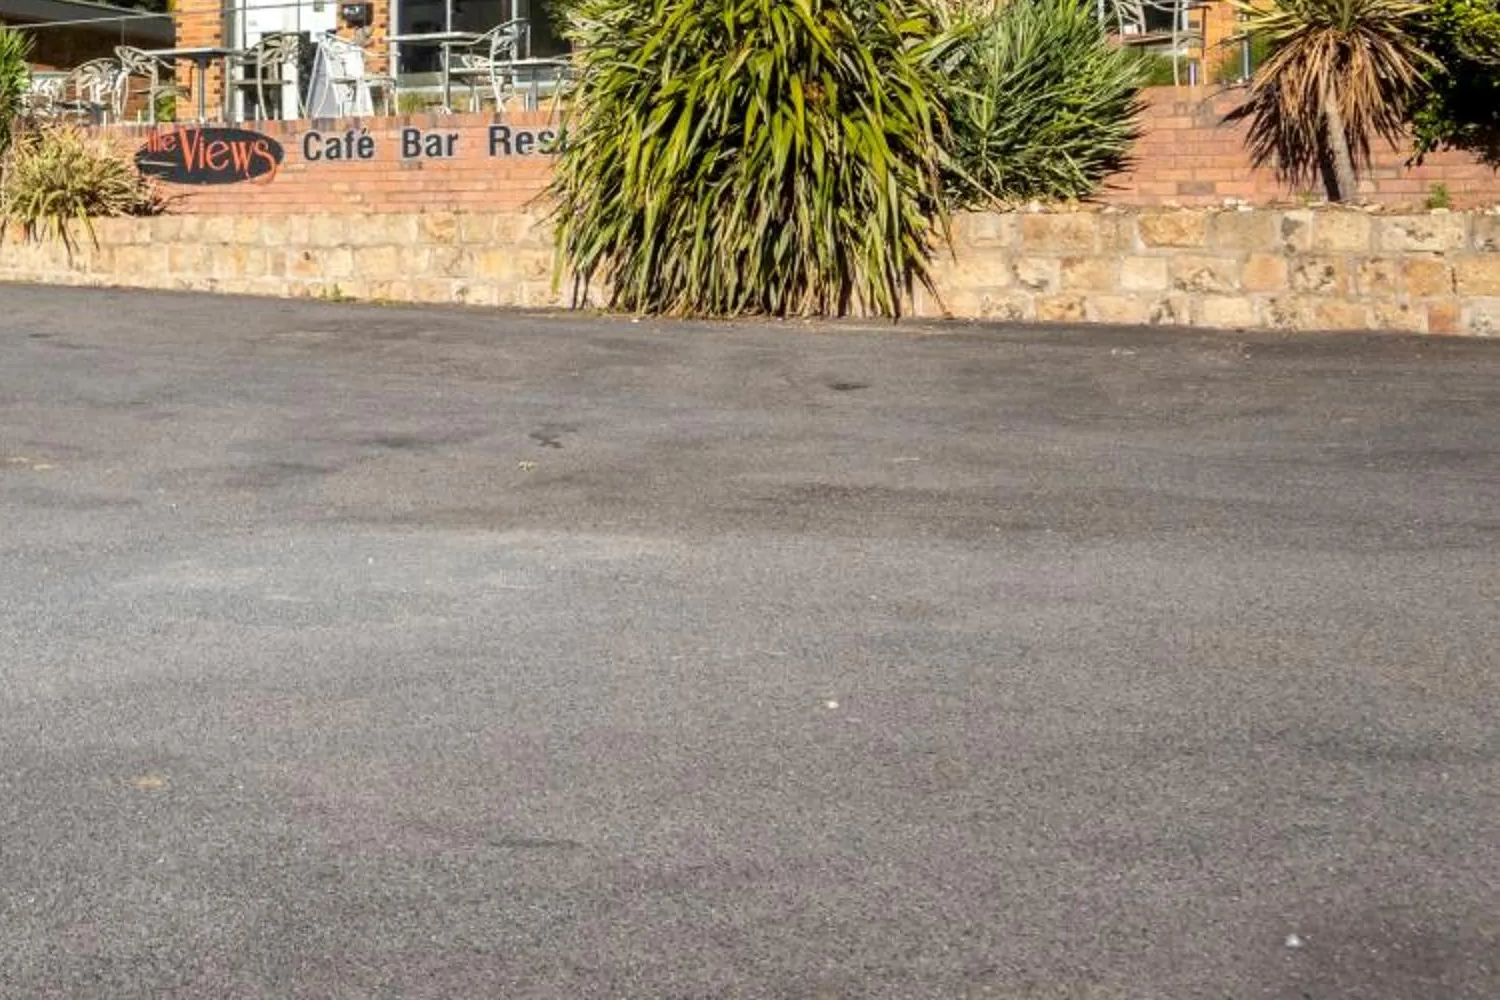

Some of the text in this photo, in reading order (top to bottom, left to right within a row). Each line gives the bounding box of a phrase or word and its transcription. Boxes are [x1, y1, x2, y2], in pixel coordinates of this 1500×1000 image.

[179, 125, 277, 184] Views
[303, 127, 375, 161] Café
[402, 128, 459, 158] Bar
